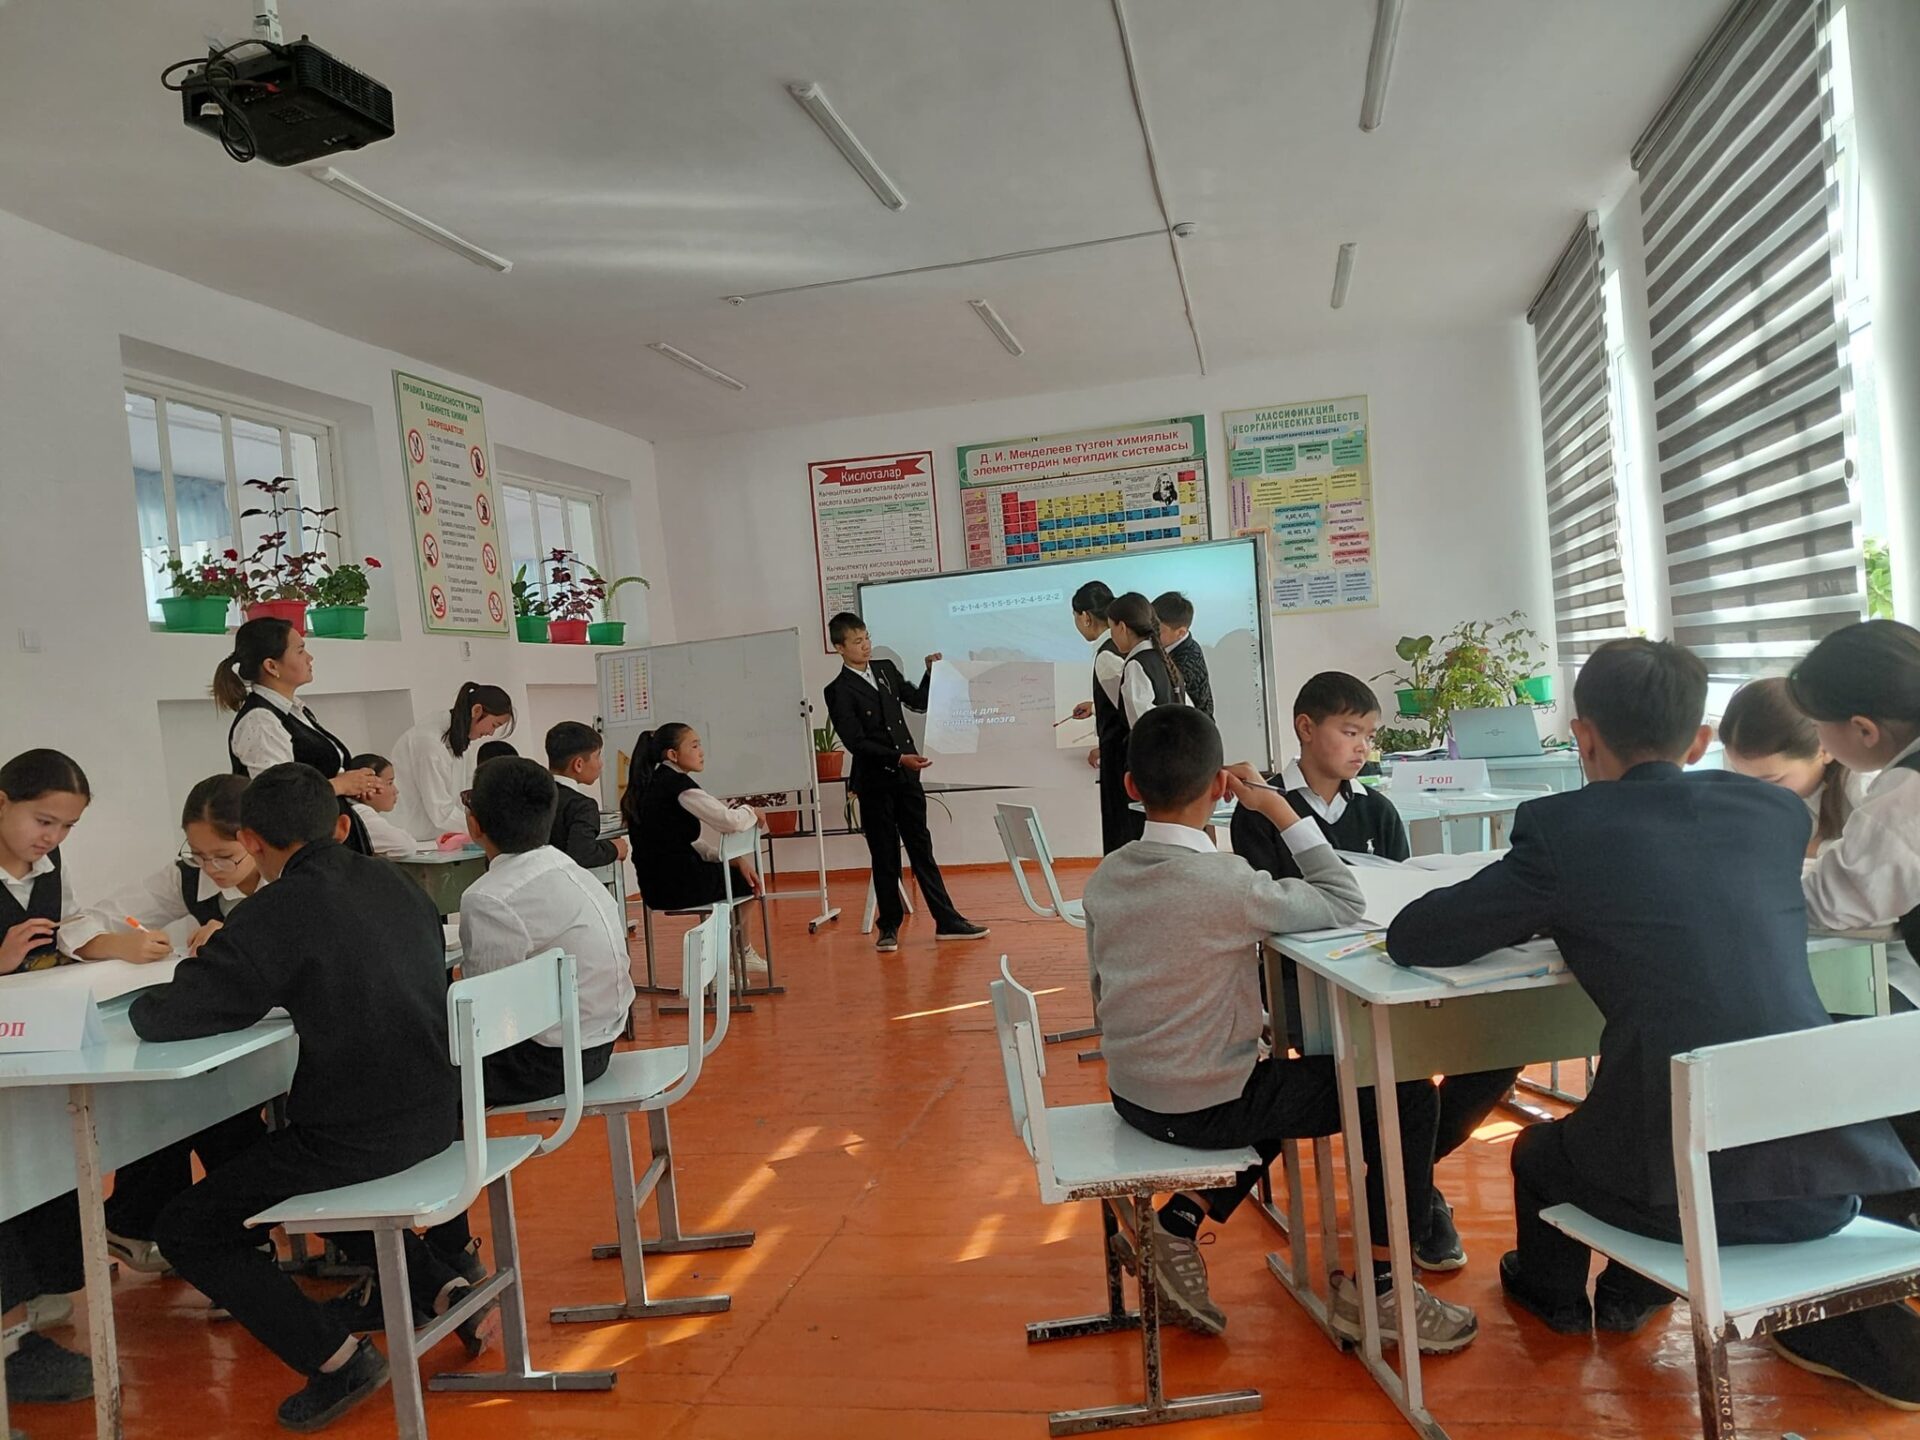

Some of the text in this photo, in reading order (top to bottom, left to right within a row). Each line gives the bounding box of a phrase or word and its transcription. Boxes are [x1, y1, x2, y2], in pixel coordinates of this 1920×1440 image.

[402, 382, 426, 397] ПРАВИЛА
[1255, 404, 1335, 422] КЛАССИФИКАЦИЯ
[1232, 411, 1360, 434] НЕОРГАНИЧЕСКИХ ВЕЩЕСТВ
[980, 430, 1179, 465] Д. И. Менделеев түзгөн химиялык
[972, 457, 1060, 476] элементтердин
[1122, 441, 1189, 457] системасы
[841, 468, 901, 482] Кислоталар
[863, 483, 910, 493] кислоталардын
[818, 499, 842, 507] кислота
[894, 491, 929, 501] формуласы
[900, 566, 935, 575] формуласы
[980, 706, 999, 715] для
[986, 715, 1016, 725] мозга
[1417, 774, 1454, 785] 1-топ
